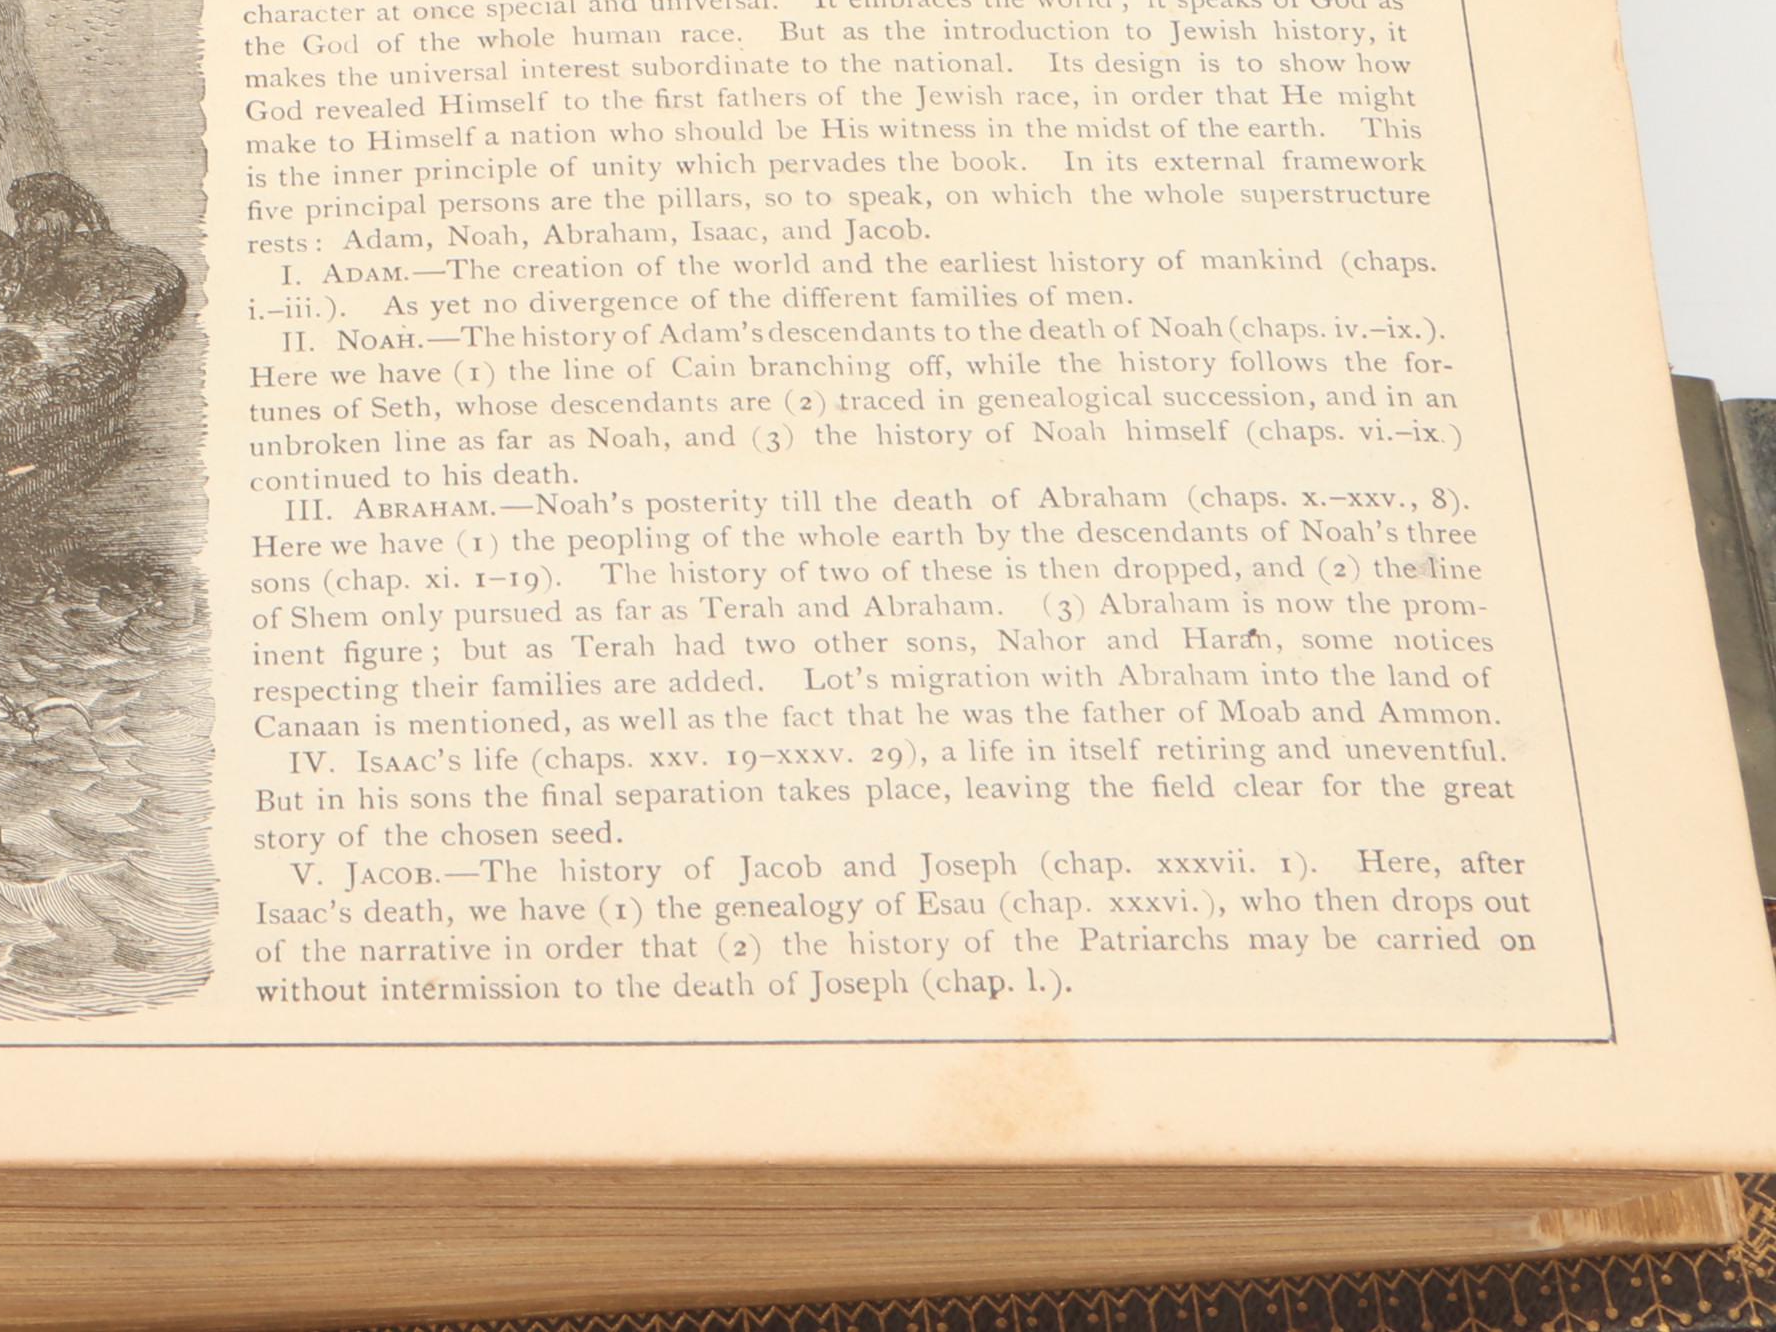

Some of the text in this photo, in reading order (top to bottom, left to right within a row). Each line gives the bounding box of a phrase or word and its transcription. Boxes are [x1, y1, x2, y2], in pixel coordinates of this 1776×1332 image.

[343, 227, 433, 252] Adam,
[447, 223, 529, 250] Noah,
[543, 221, 678, 246] Abraham,
[691, 220, 768, 245] Isaac,
[782, 218, 832, 241] and
[844, 217, 931, 247] Jacob.
[285, 498, 332, 522] III.
[645, 488, 768, 521] posterity
[781, 489, 822, 513] till
[834, 489, 877, 513] the
[893, 487, 973, 512] death
[991, 486, 1021, 510] of
[1038, 484, 1167, 509] Abraham
[1187, 484, 1287, 514] (chaps.
[289, 861, 323, 886] V.
[559, 857, 662, 889] history
[684, 855, 715, 881] of
[738, 853, 822, 887] Jacob
[843, 852, 897, 878] and
[919, 850, 1017, 883] Joseph
[1040, 849, 1132, 881] (chap.
[1156, 847, 1255, 874] xxxvii.
[1356, 848, 1441, 879] Here,
[1460, 850, 1526, 876] after
[255, 976, 367, 1003] without
[380, 973, 561, 1002] intermission
[574, 979, 603, 1000] to
[615, 973, 661, 999] the
[673, 971, 755, 998] death
[768, 970, 799, 997] of
[809, 968, 909, 1003] Joseph
[922, 968, 1014, 1001] (chap.
